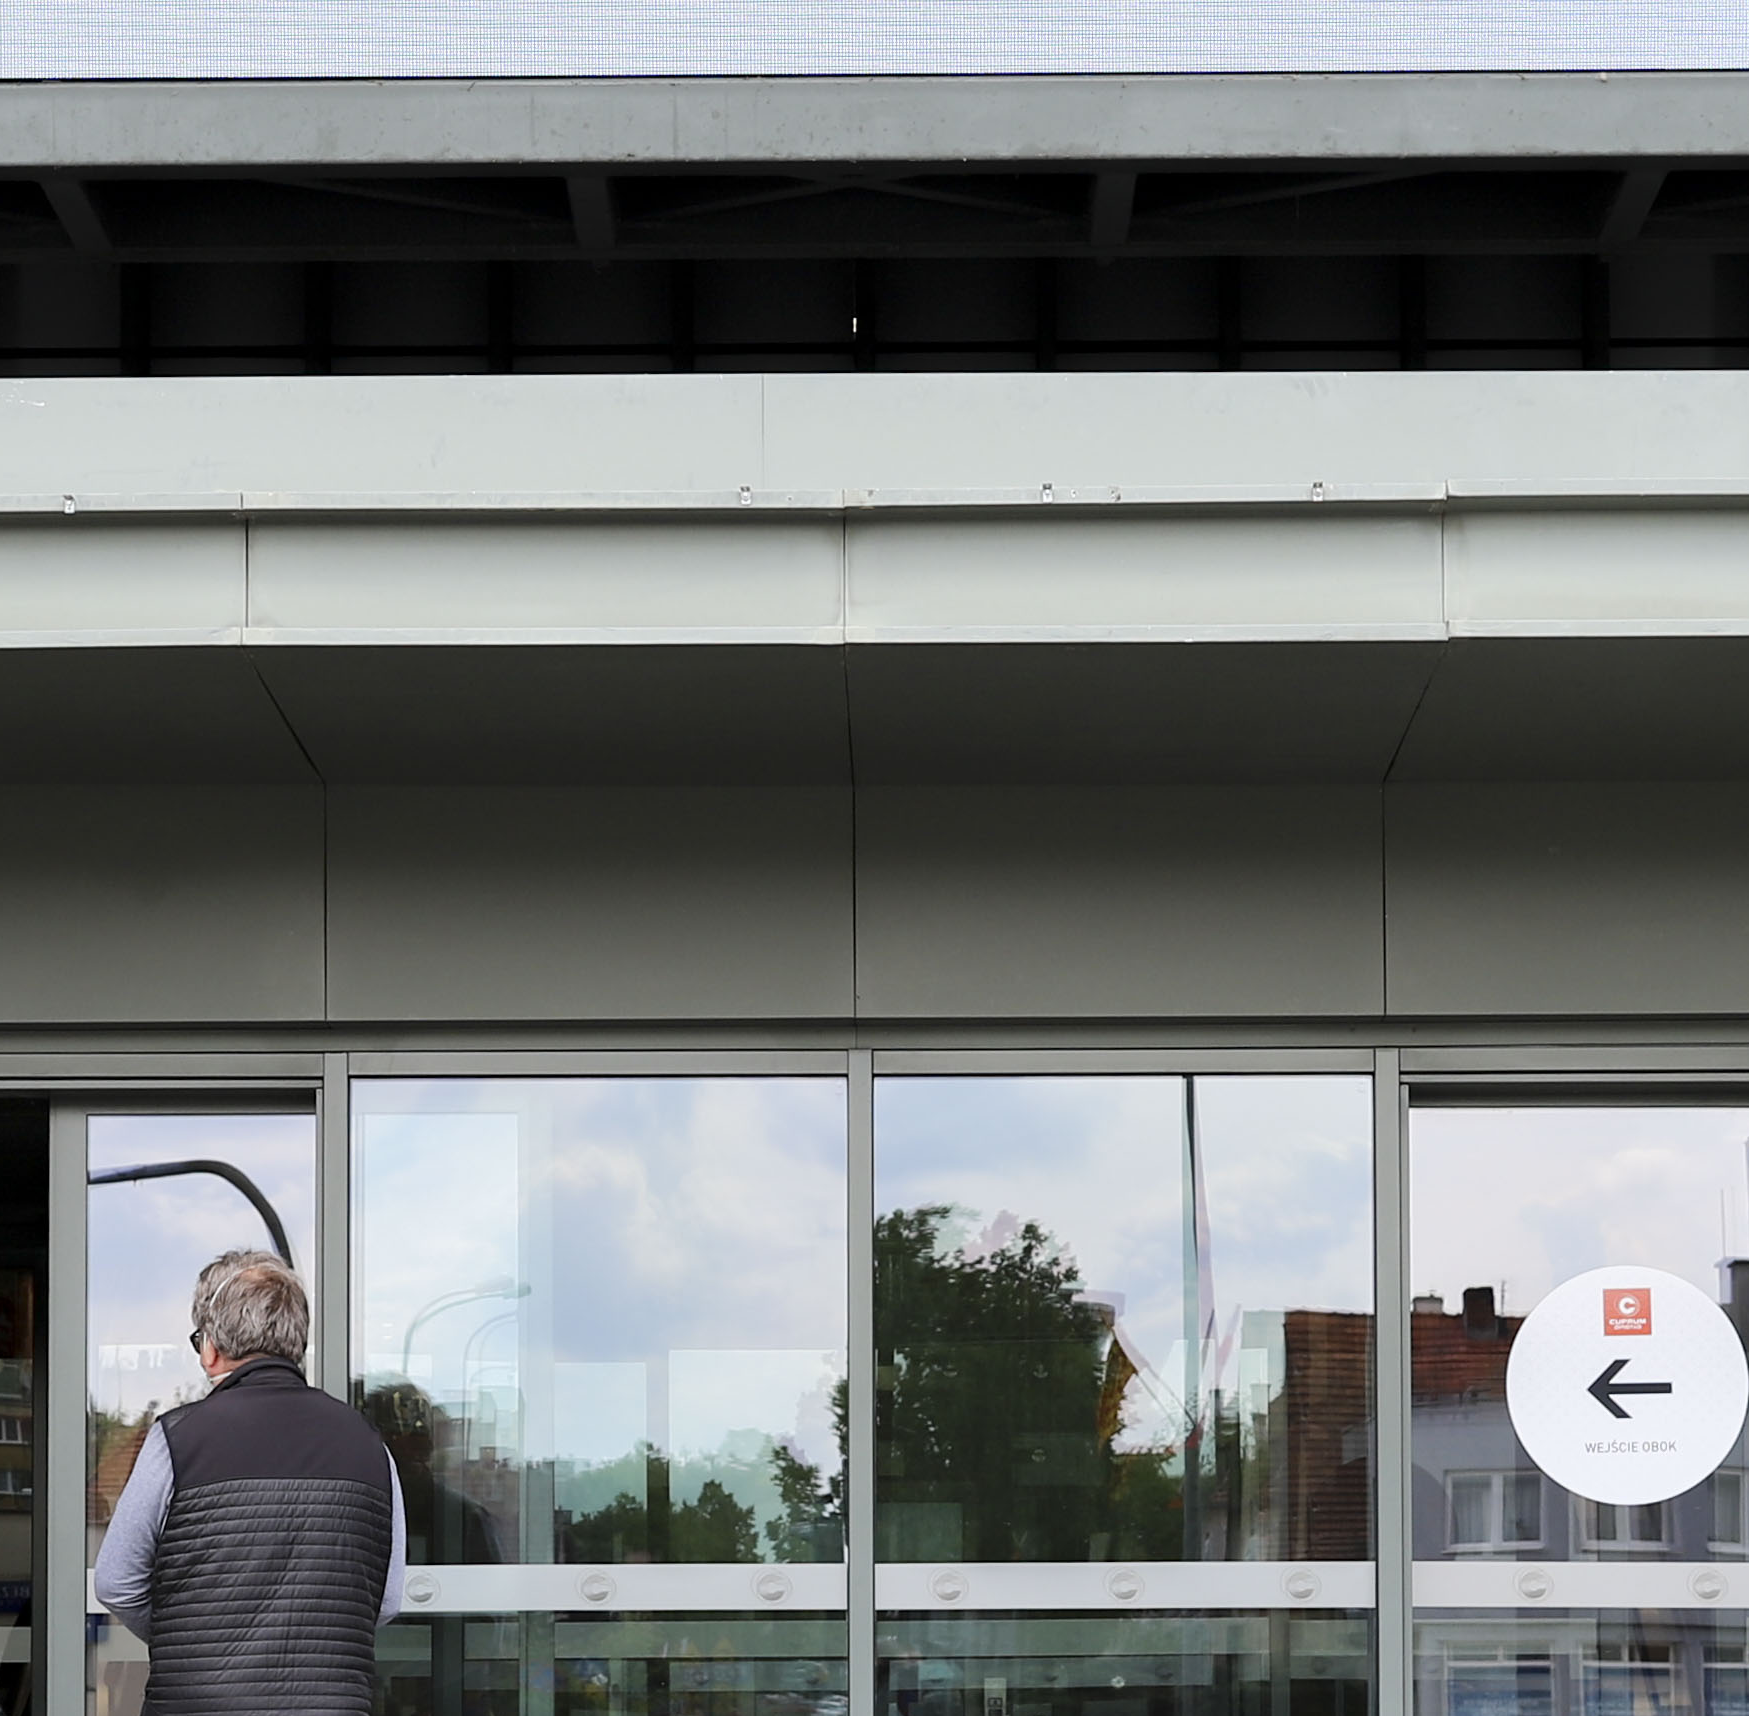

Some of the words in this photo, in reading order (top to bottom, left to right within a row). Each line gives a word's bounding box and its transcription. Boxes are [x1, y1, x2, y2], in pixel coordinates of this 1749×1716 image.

[1609, 1318, 1647, 1326] CUPRUM
[1585, 1440, 1639, 1453] WEJŚCIE
[1642, 1440, 1677, 1453] OBOK
